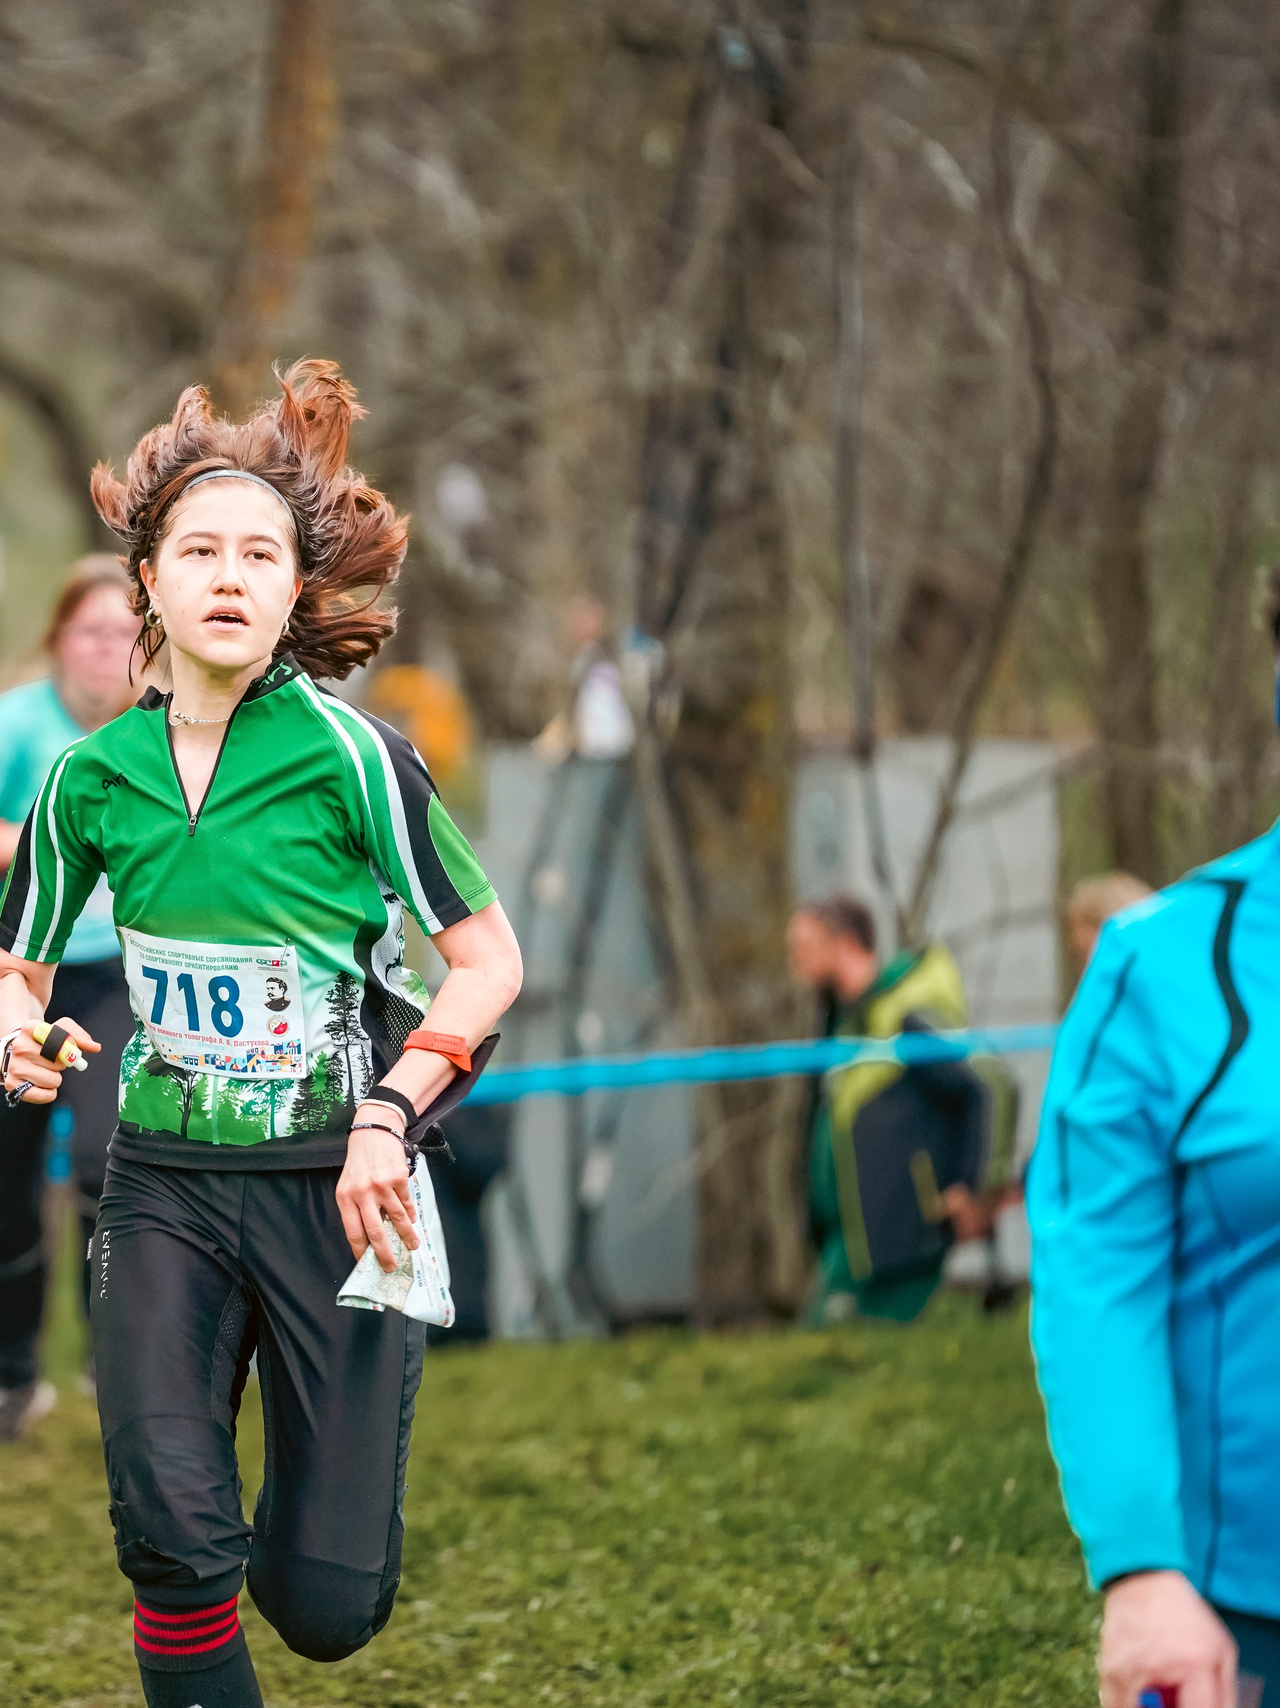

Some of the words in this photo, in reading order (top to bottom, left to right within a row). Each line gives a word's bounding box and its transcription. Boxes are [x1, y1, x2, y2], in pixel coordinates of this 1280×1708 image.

[145, 954, 183, 967] СПОРТИВНОМУ
[184, 961, 239, 971] ОРИЕНТИРОВАНИЮ
[168, 950, 204, 962] СПОРТИВНЫЕ
[142, 965, 244, 1038] 718
[184, 1033, 217, 1044] топографа
[233, 1040, 270, 1048] Пастухова
